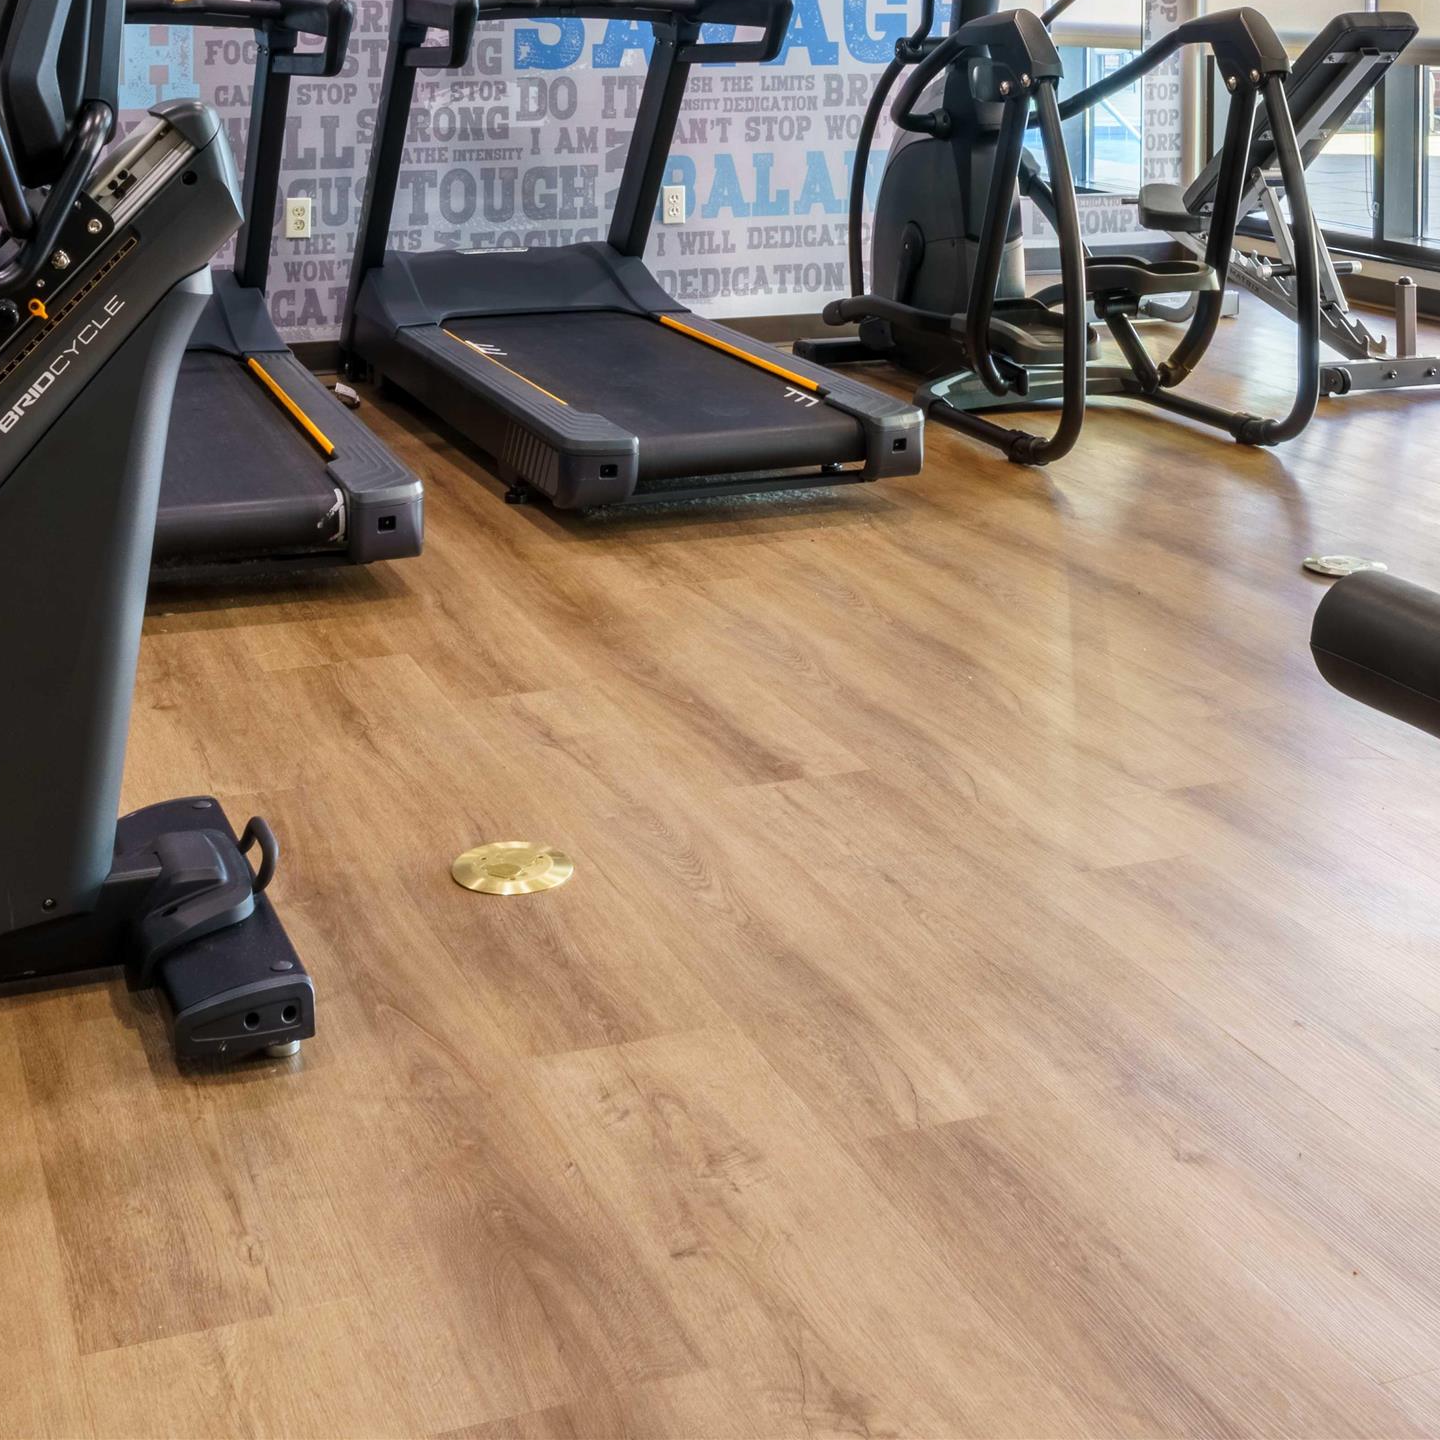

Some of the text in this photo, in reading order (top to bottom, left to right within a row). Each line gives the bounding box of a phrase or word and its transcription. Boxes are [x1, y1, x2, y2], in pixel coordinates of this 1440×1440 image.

[297, 84, 357, 105] STOP
[450, 81, 506, 102] STOP
[720, 76, 753, 92] THE
[761, 75, 815, 91] LIMITS
[516, 76, 577, 121] DO
[723, 96, 818, 112] DEDICATION
[530, 126, 598, 155] I AM
[745, 116, 811, 142] STOP
[452, 148, 523, 161] INTENSITY
[400, 165, 598, 226] TOUGH
[657, 230, 736, 256] I WILL
